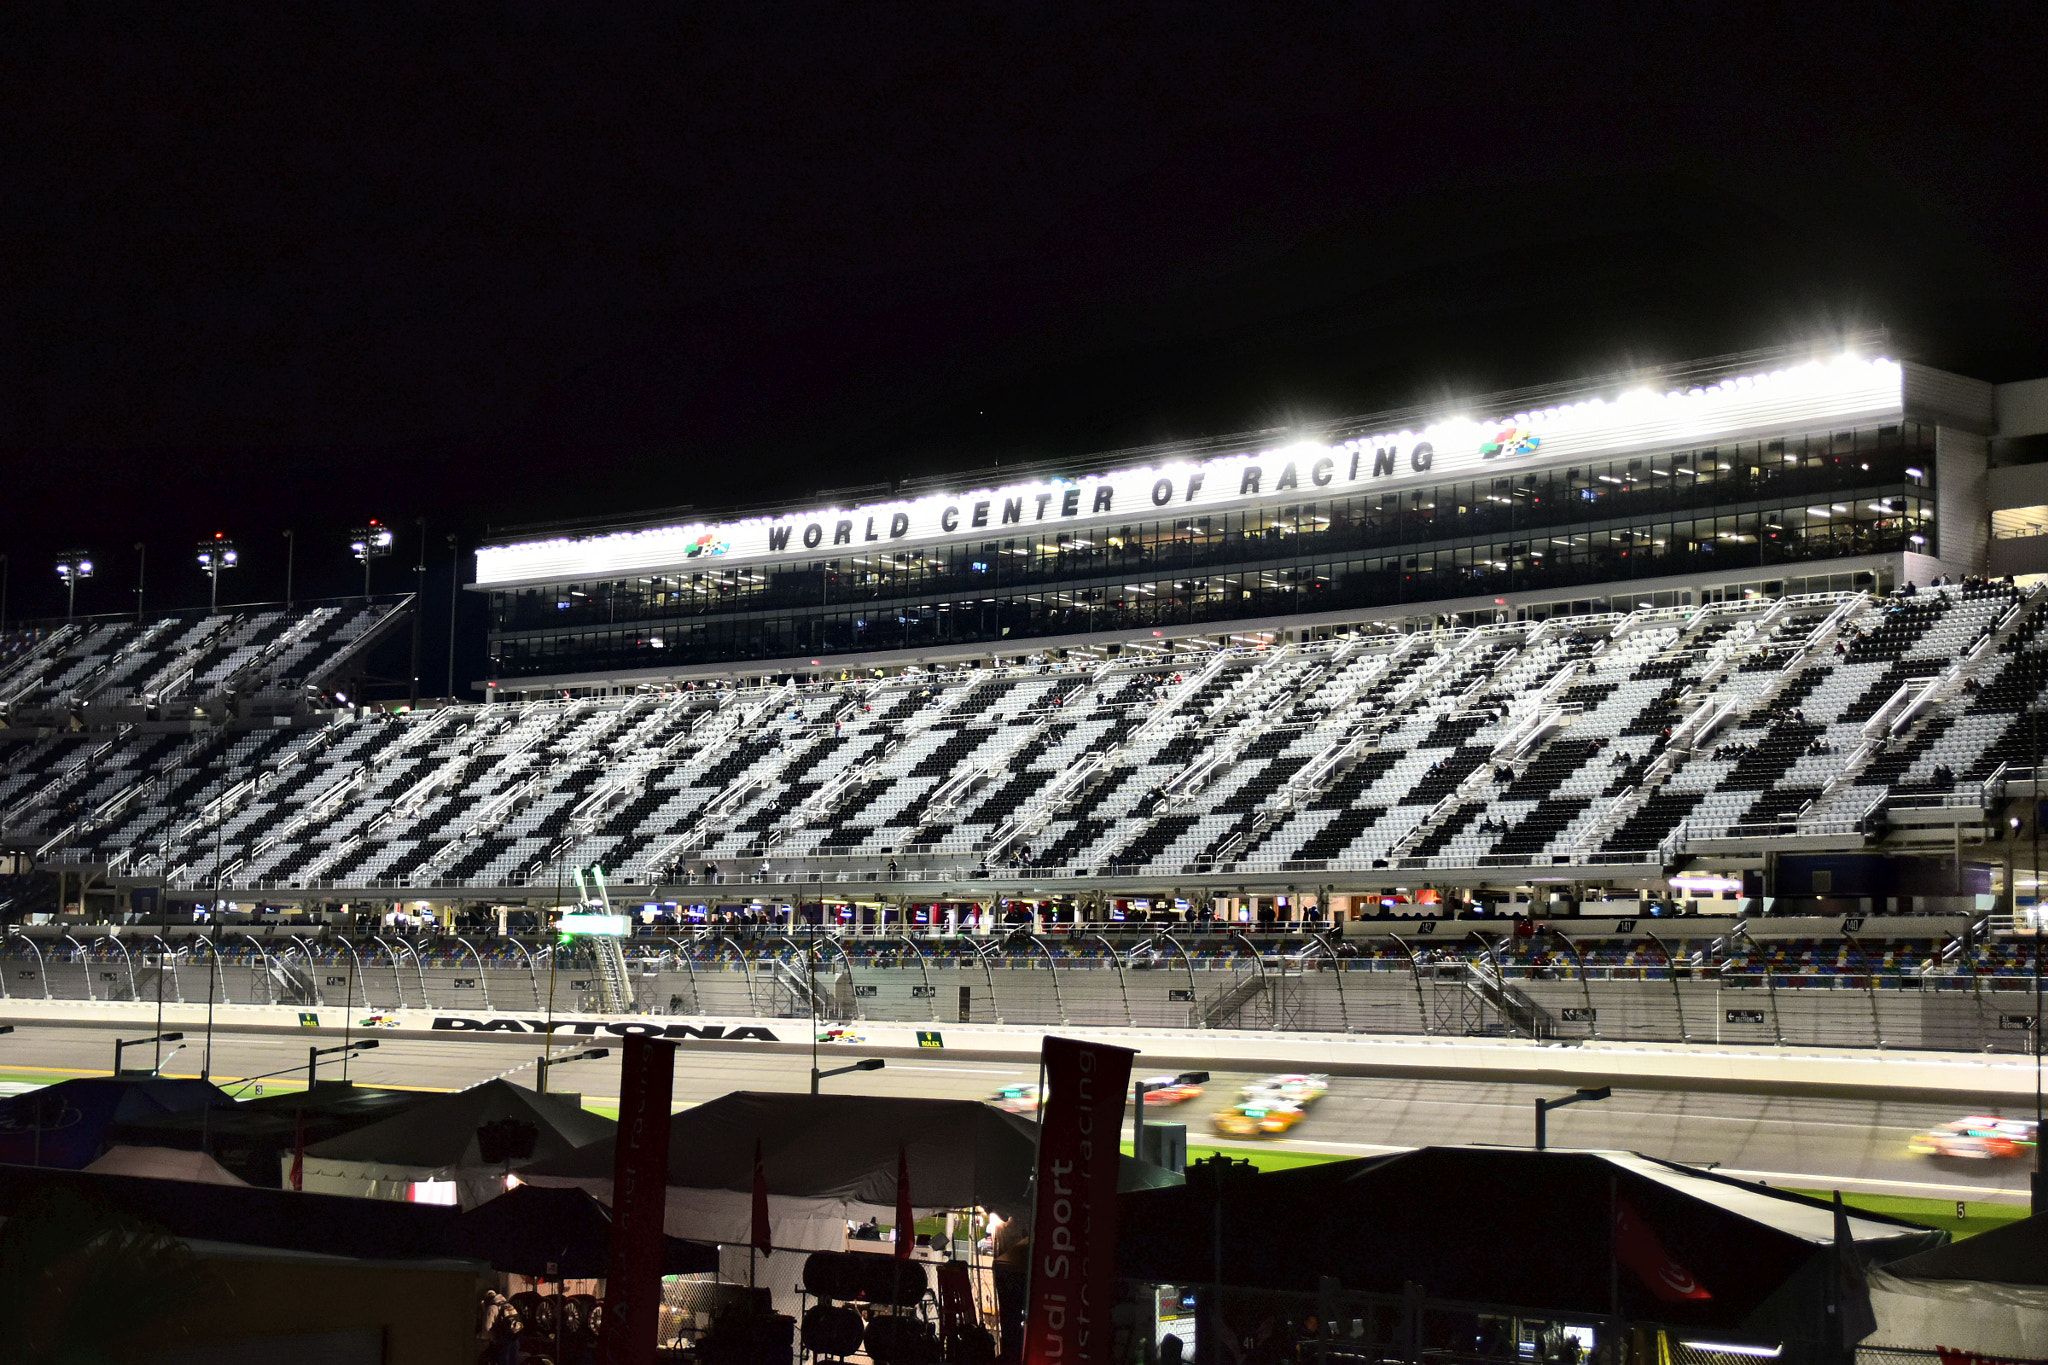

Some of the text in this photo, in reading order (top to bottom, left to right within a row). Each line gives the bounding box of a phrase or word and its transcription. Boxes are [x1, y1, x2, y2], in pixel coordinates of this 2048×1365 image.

[769, 442, 1434, 551] WORLD CENTER OF RACING
[1621, 921, 1632, 932] 141
[1846, 919, 1859, 931] 140
[432, 1017, 781, 1042] DAYTONA
[1075, 1049, 1097, 1178] racing
[1043, 1157, 1075, 1365] udi Sport
